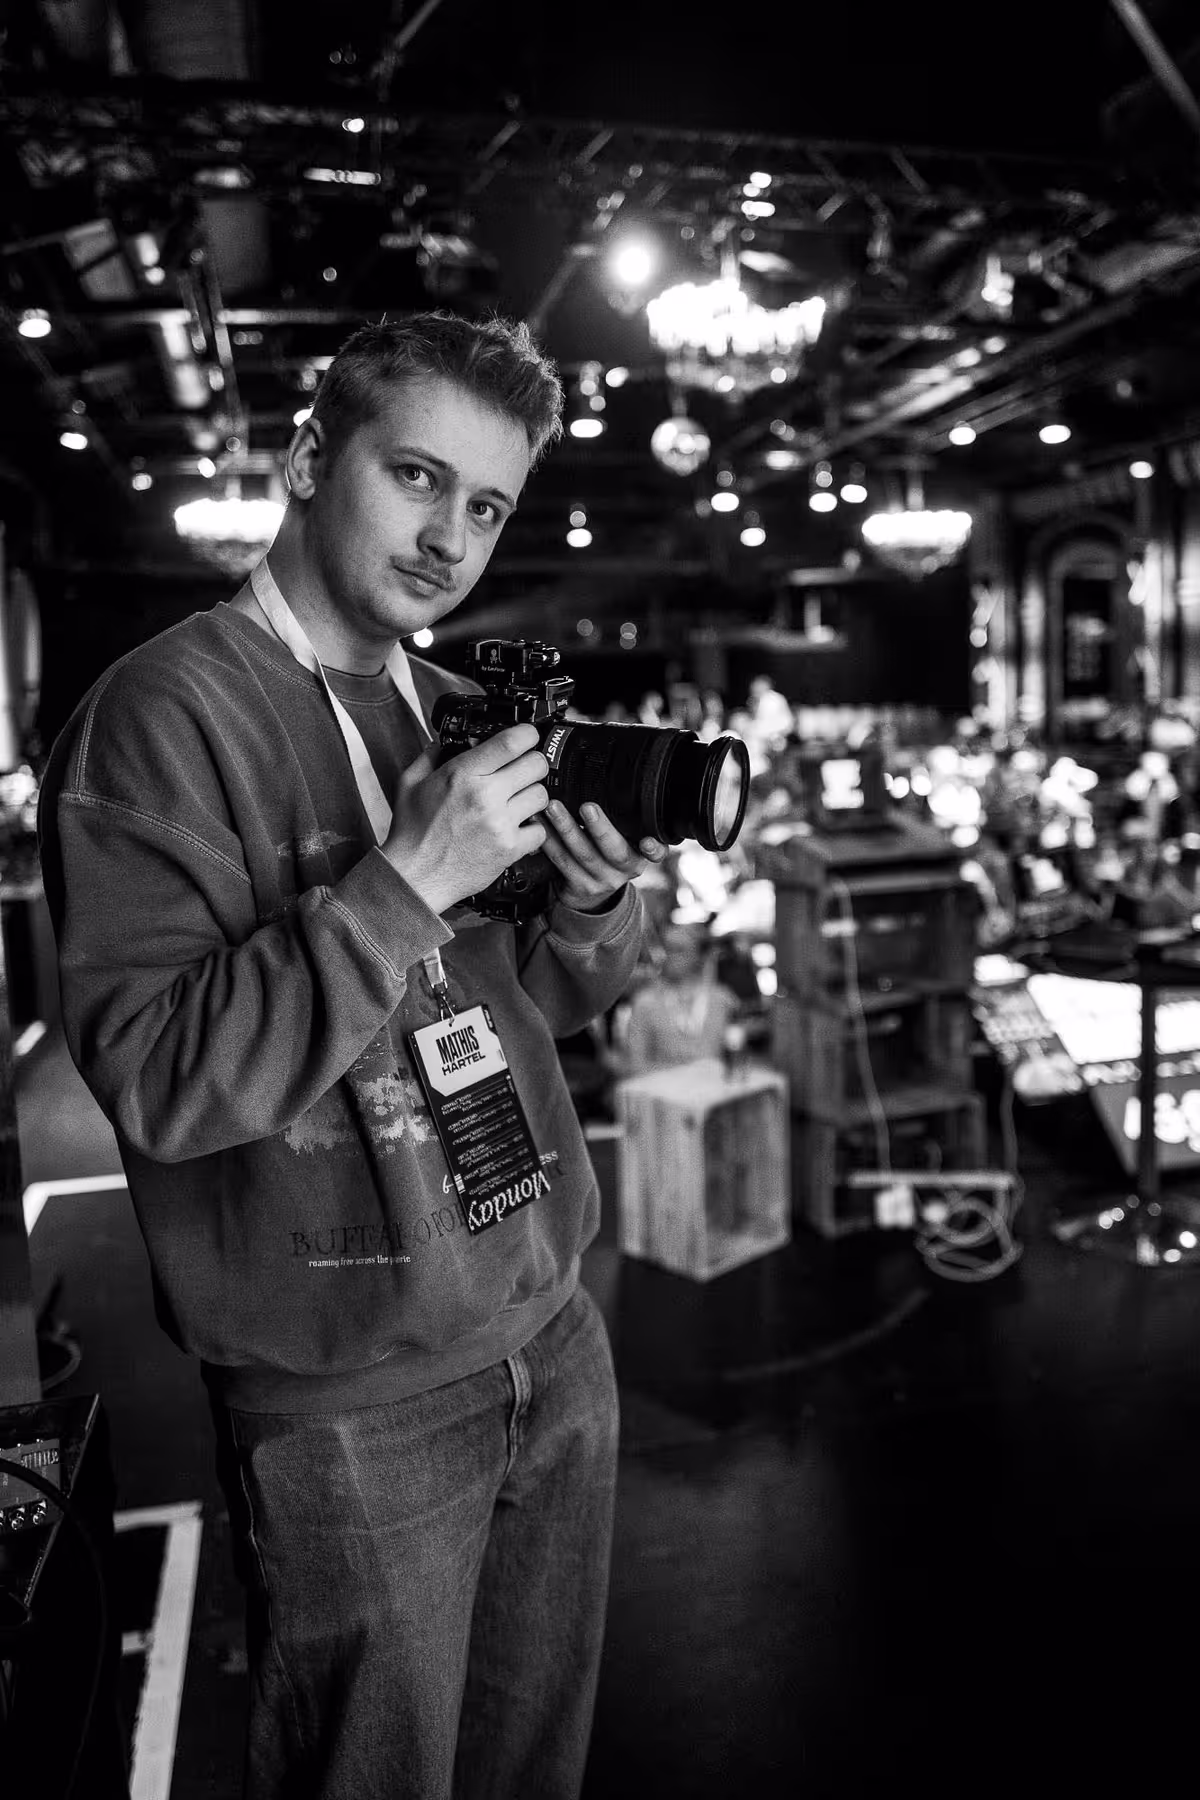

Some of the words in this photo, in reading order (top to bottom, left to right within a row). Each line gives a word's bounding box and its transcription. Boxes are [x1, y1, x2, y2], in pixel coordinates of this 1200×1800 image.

[546, 729, 566, 762] TWIST
[435, 1025, 479, 1064] MATHIS
[308, 1260, 339, 1268] roaming
[340, 1257, 354, 1266] free
[377, 1254, 388, 1264] the
